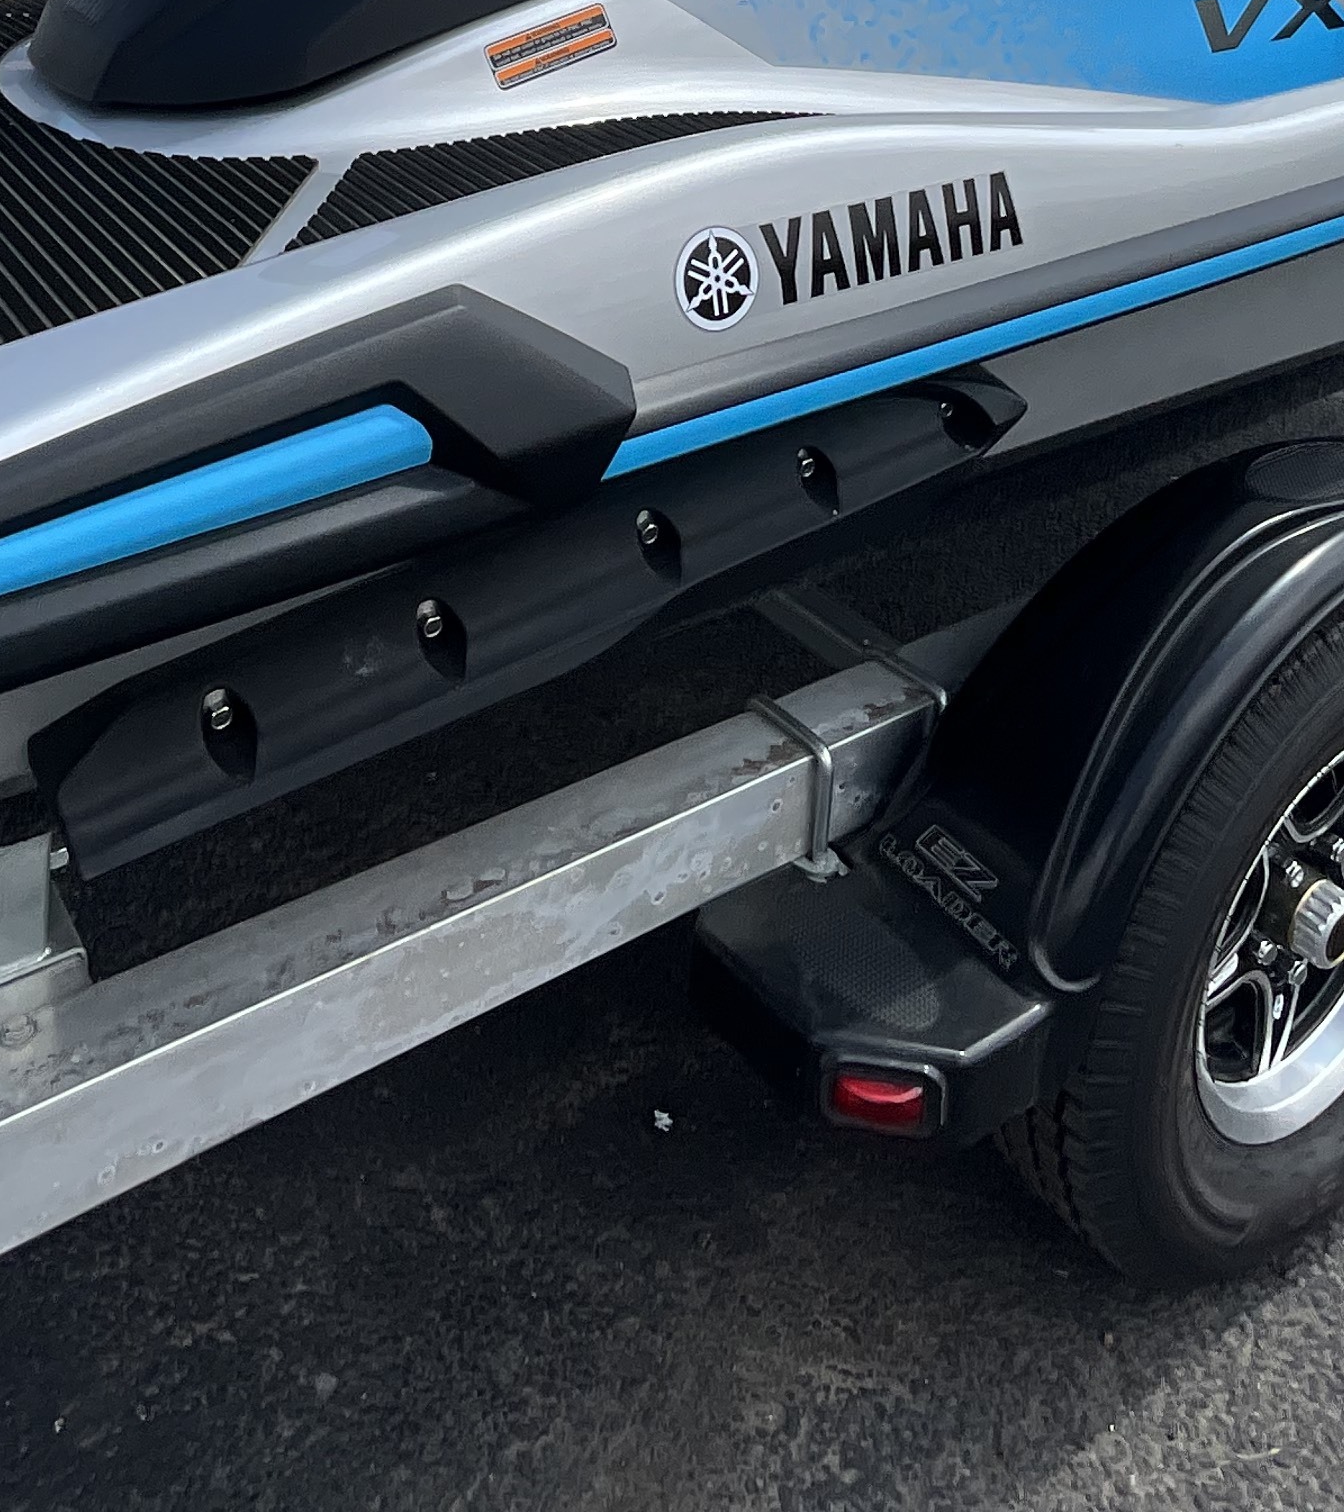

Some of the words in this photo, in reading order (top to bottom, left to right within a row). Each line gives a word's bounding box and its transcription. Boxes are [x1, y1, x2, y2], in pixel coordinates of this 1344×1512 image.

[759, 170, 1024, 305] YAMAHA
[878, 832, 1019, 971] LOADER
[915, 823, 999, 903] EZ
